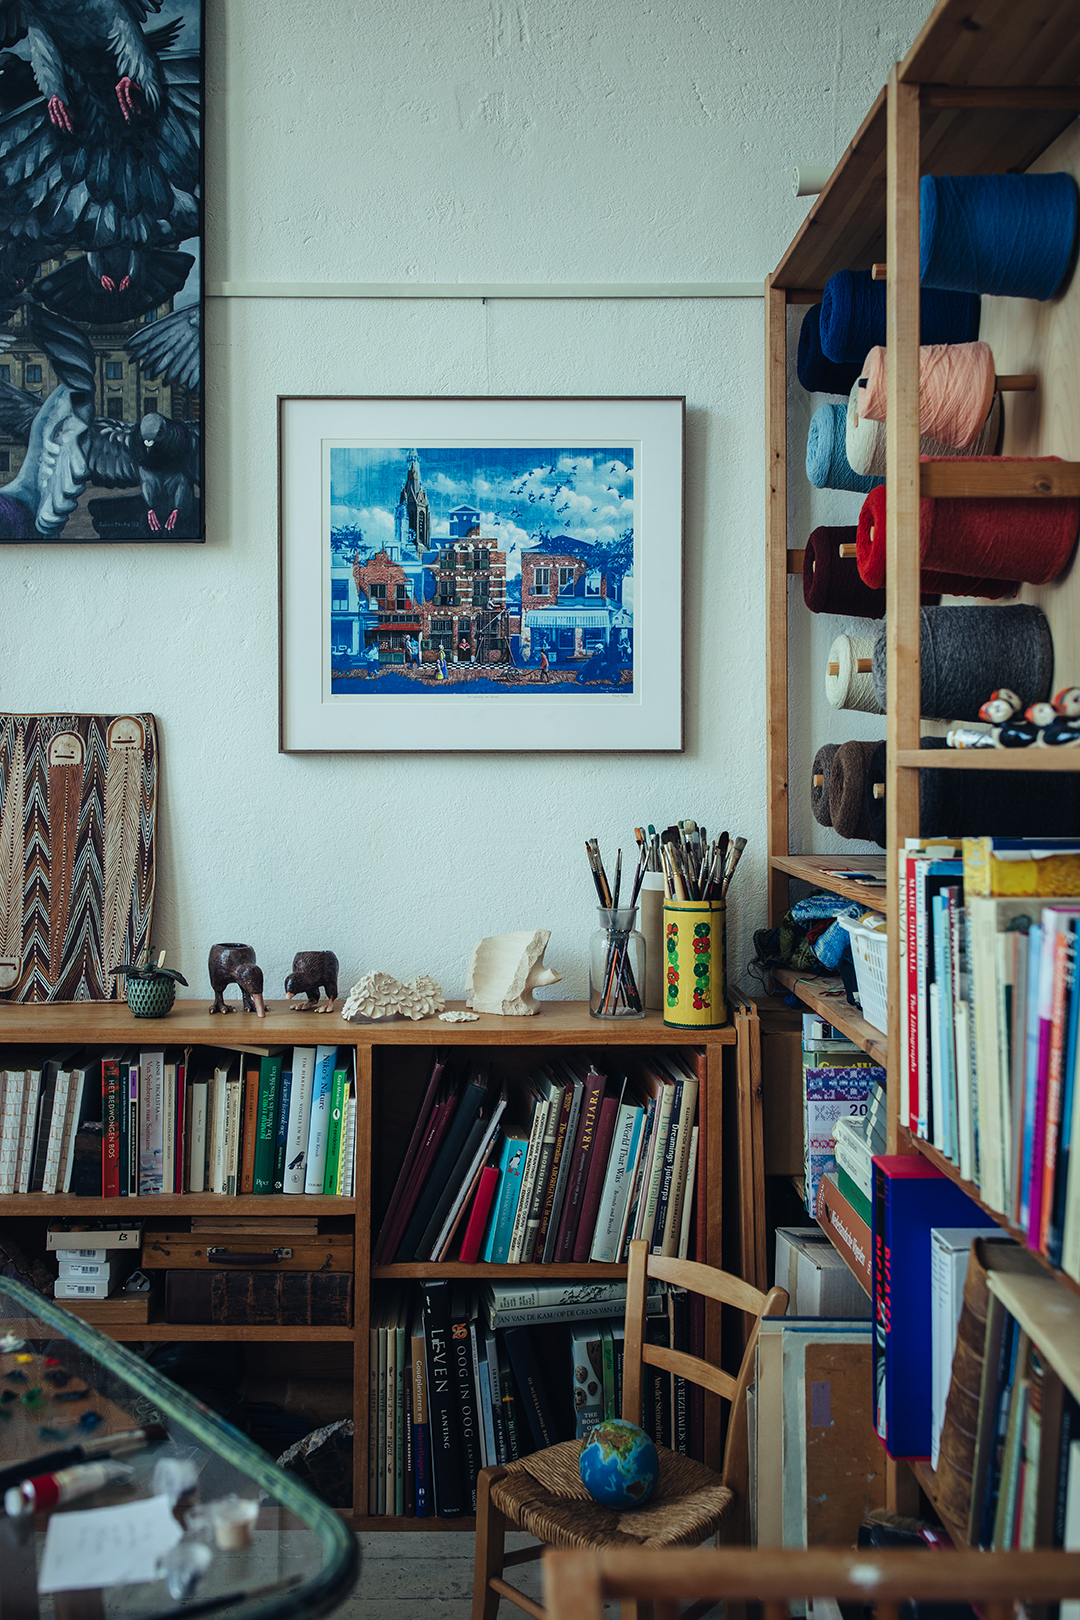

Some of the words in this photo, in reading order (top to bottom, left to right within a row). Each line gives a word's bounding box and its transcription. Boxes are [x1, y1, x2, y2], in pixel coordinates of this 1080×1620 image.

[908, 878, 916, 912] MARC
[908, 916, 916, 973] CHAGALL
[909, 994, 917, 1013] The
[909, 1014, 917, 1072] Lithographs
[321, 1055, 330, 1080] Niko's
[144, 1074, 152, 1108] Spitsbergen
[268, 1066, 277, 1101] Menschlichen
[319, 1083, 328, 1110] Nature
[261, 1090, 269, 1113] LORENZ
[547, 1088, 560, 1135] AUSTRALIAN
[297, 1126, 301, 1134] EN
[531, 1115, 540, 1142] ABORIGINAL
[537, 1113, 546, 1139] ABORIGINAL
[559, 1122, 567, 1135] The
[579, 1087, 599, 1150] ARATJARA
[660, 1114, 670, 1135] The
[621, 1120, 633, 1145] World
[666, 1124, 679, 1163] Dreamings
[553, 1135, 564, 1163] Australian
[618, 1146, 628, 1165] That
[656, 1137, 667, 1161] Dark
[524, 1157, 532, 1182] PAINTINGS
[529, 1153, 538, 1179] PAINTINGS
[536, 1150, 549, 1194] ABORIGINAL
[615, 1166, 625, 1183] Was
[256, 1178, 269, 1187] Piper
[503, 1182, 512, 1199] ADAM
[545, 1164, 559, 1208] ABORIGINAL
[648, 1165, 663, 1218] Australians
[661, 1165, 674, 1201] Tjukurrpa
[611, 1189, 619, 1206] Berndt
[540, 1216, 549, 1234] colour
[606, 1217, 614, 1234] Berndt
[497, 1315, 510, 1323] JAN
[576, 1307, 598, 1315] GRENS
[613, 1303, 625, 1311] LAN
[456, 1345, 469, 1377] OOG
[415, 1360, 423, 1411] Goudplevieren
[430, 1329, 450, 1392] LEVEN
[441, 1409, 450, 1448] LANTING
[459, 1383, 470, 1399] IN
[492, 1368, 500, 1402] LOKVOGELS
[527, 1376, 533, 1384] DE
[417, 1413, 422, 1422] en
[529, 1385, 546, 1428] NEDERLANDSE
[655, 1401, 663, 1430] Steinzeit
[677, 1388, 685, 1440] SCHWEIZER
[461, 1405, 474, 1438] OOG
[508, 1420, 514, 1430] DE
[417, 1426, 425, 1479] wilsterflappers
[509, 1430, 517, 1451] UILEN
[466, 1443, 476, 1480] LANTING
